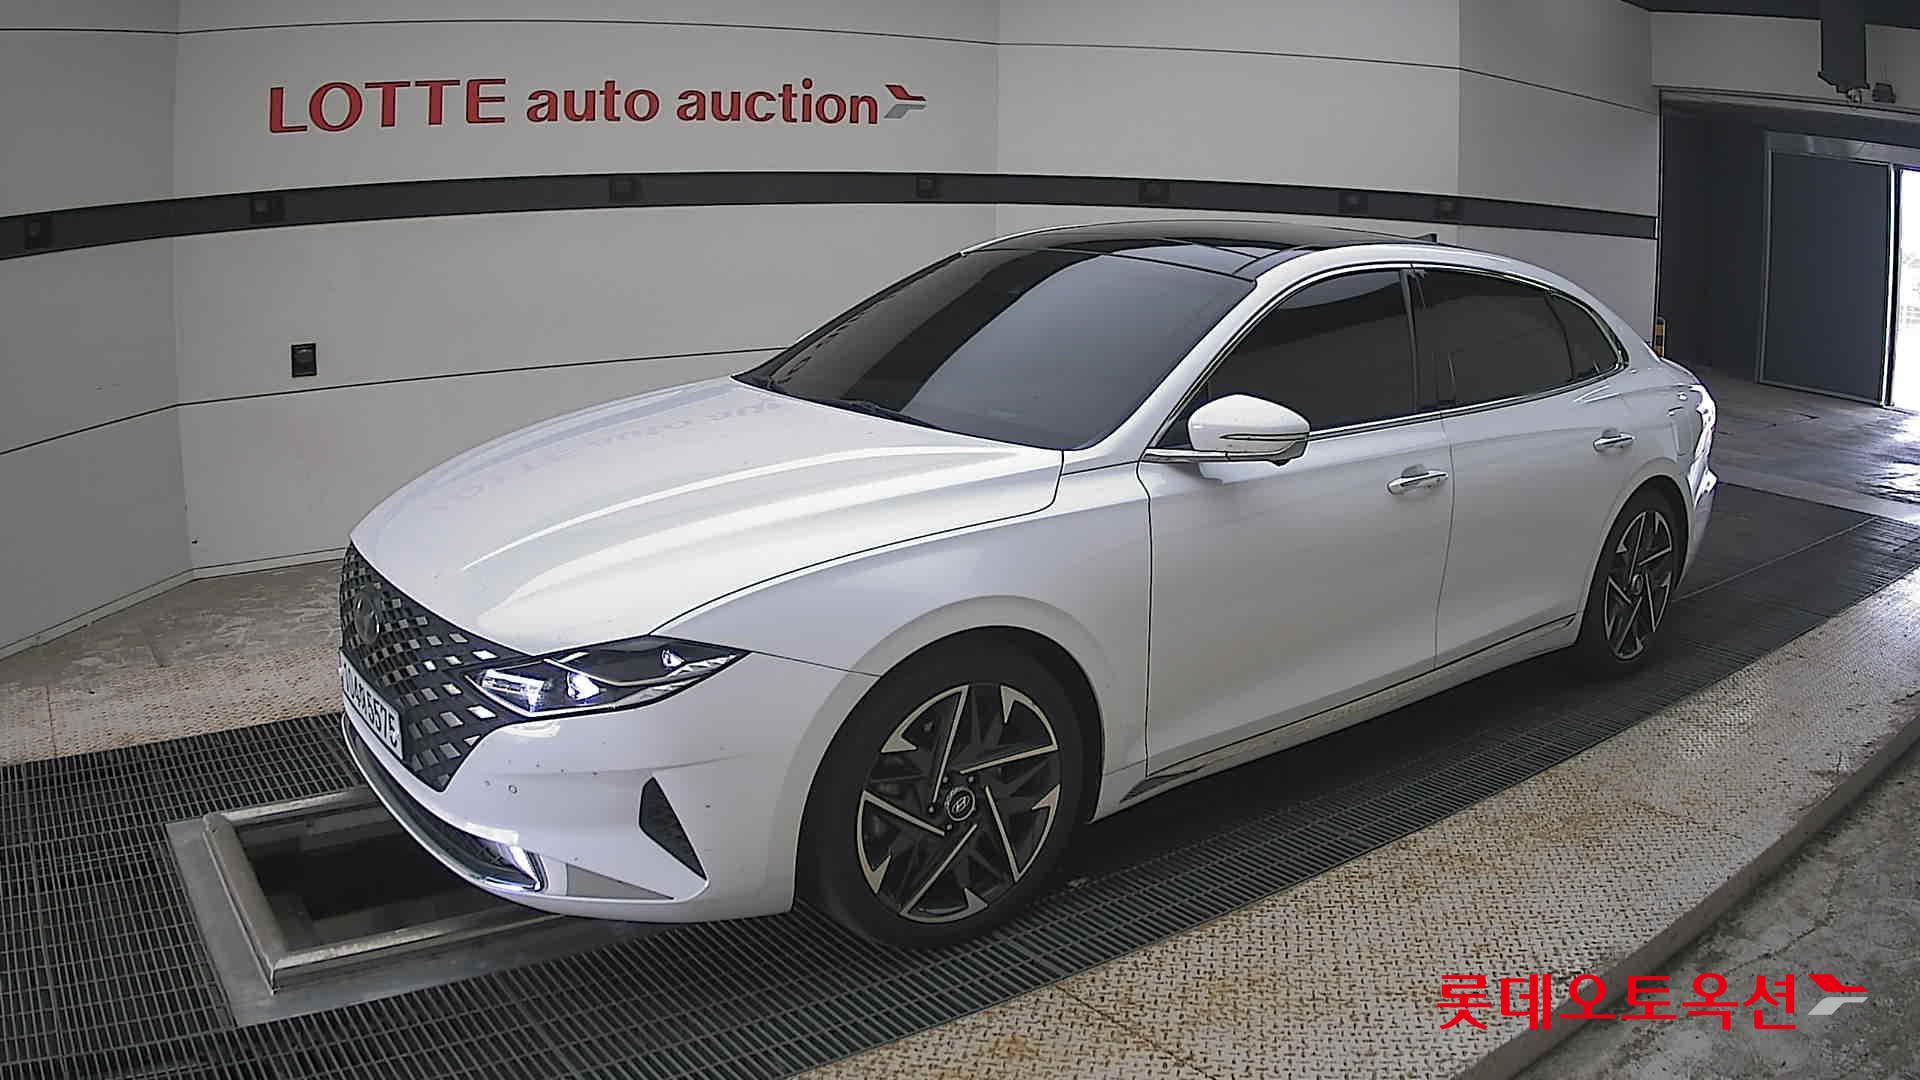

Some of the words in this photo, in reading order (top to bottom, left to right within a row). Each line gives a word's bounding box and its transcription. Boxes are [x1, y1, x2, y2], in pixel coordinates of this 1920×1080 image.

[269, 79, 506, 134] LOTTE
[526, 80, 660, 123] auto
[676, 78, 878, 125] auction
